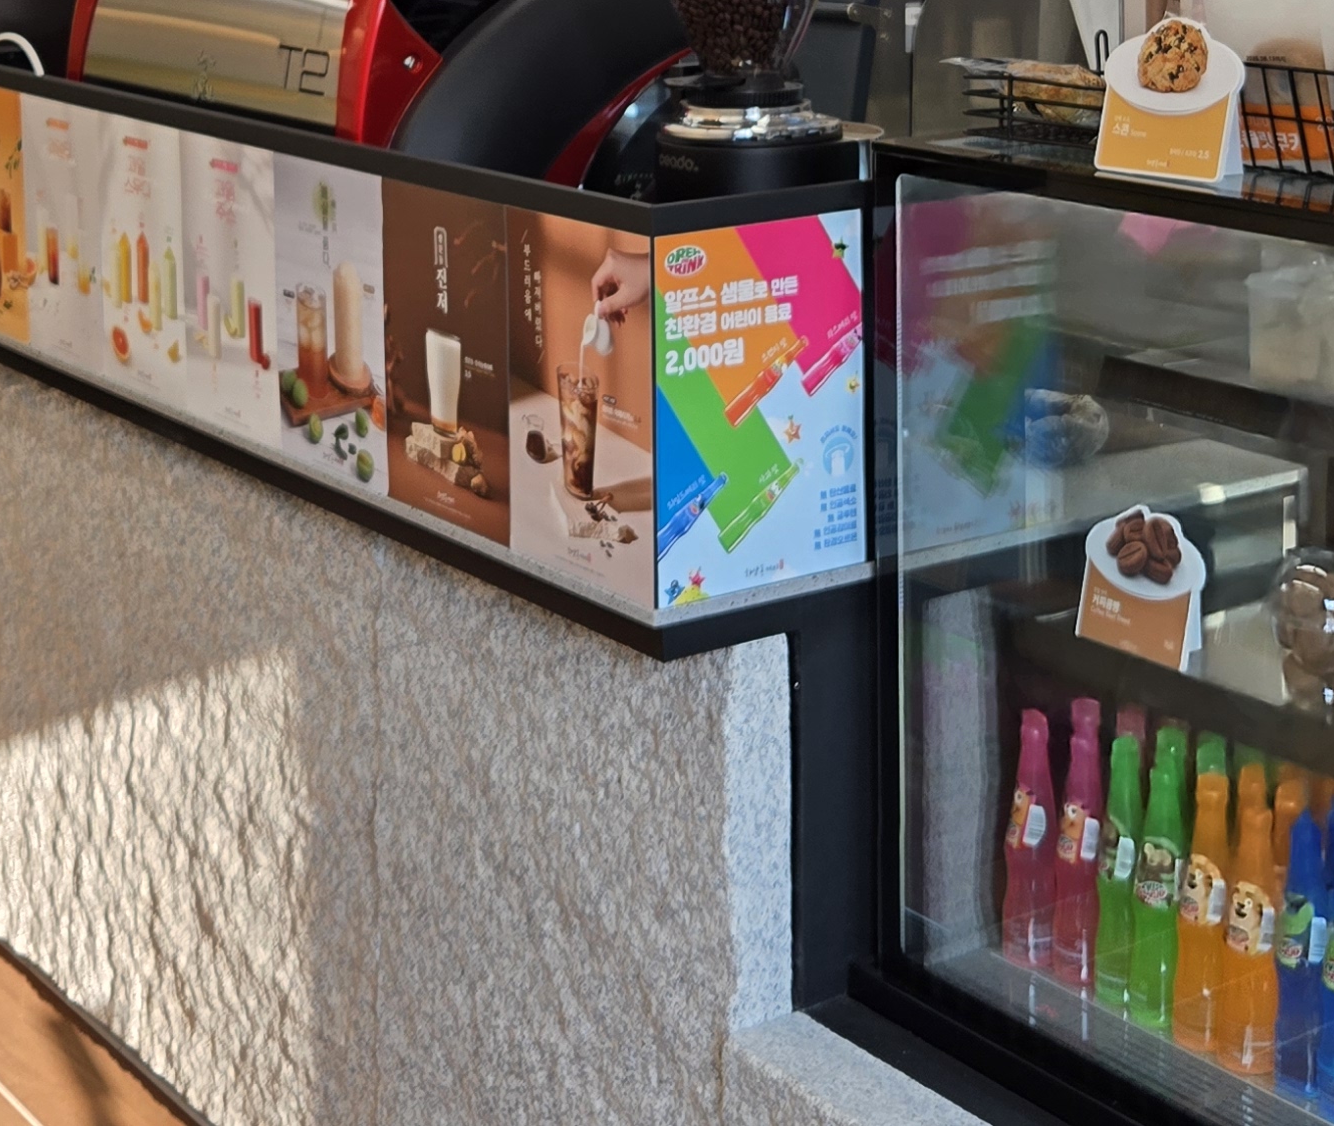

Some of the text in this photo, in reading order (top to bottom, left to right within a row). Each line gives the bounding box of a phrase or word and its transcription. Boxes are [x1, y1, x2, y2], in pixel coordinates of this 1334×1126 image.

[664, 275, 799, 314] 알프스 샘물로 만든
[665, 302, 793, 340] 친환경 어린이 음료
[665, 337, 745, 377] 2,000원
